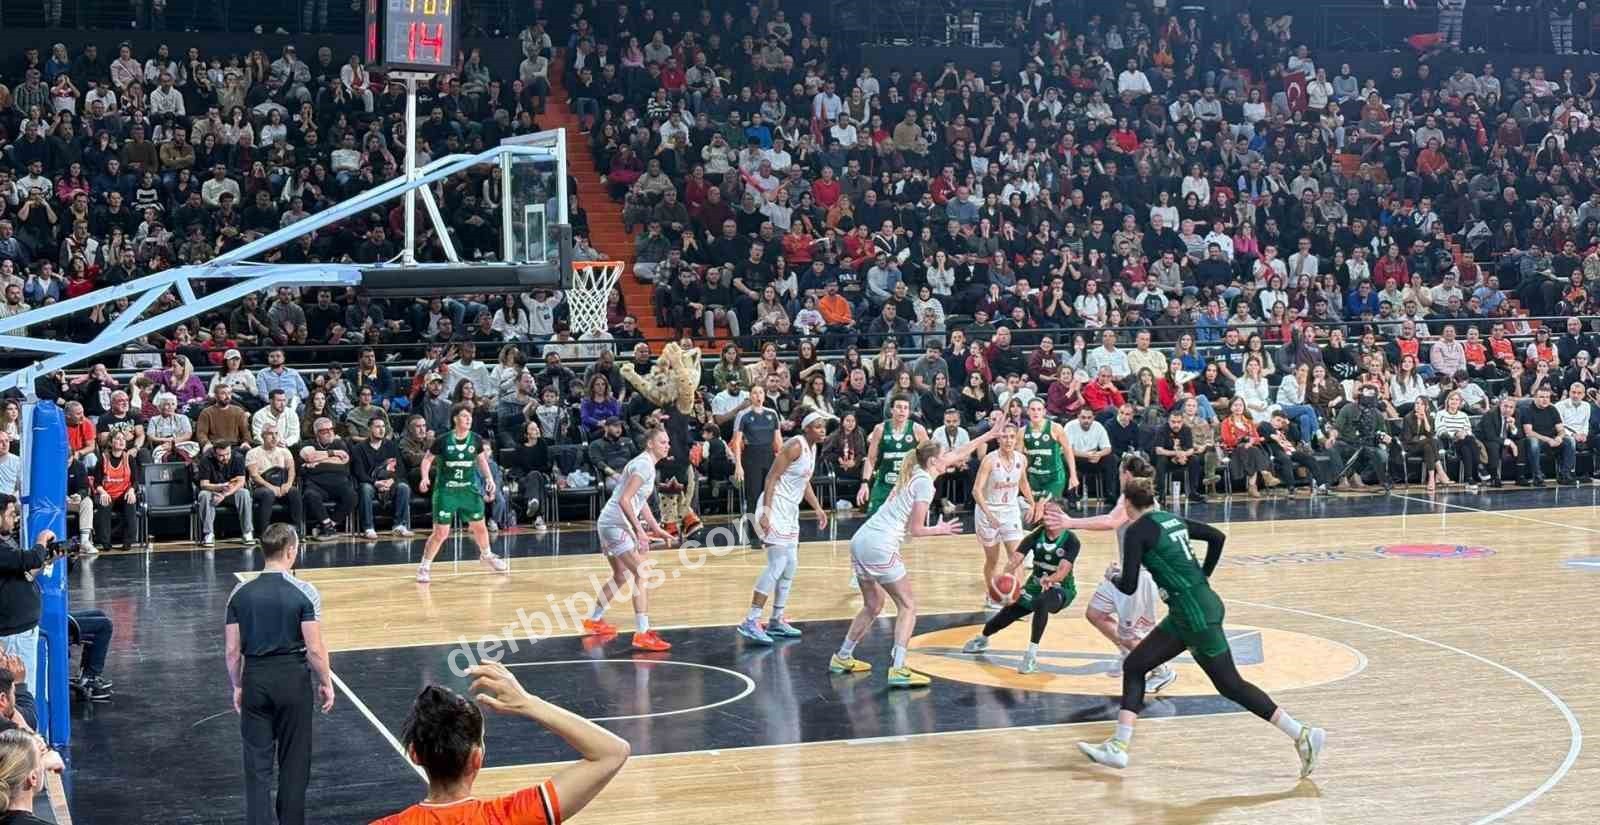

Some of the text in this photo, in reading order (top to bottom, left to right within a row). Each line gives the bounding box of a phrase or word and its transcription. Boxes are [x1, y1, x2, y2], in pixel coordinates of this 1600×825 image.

[408, 20, 443, 63] 14
[1033, 456, 1042, 467] 2
[454, 468, 464, 480] 21
